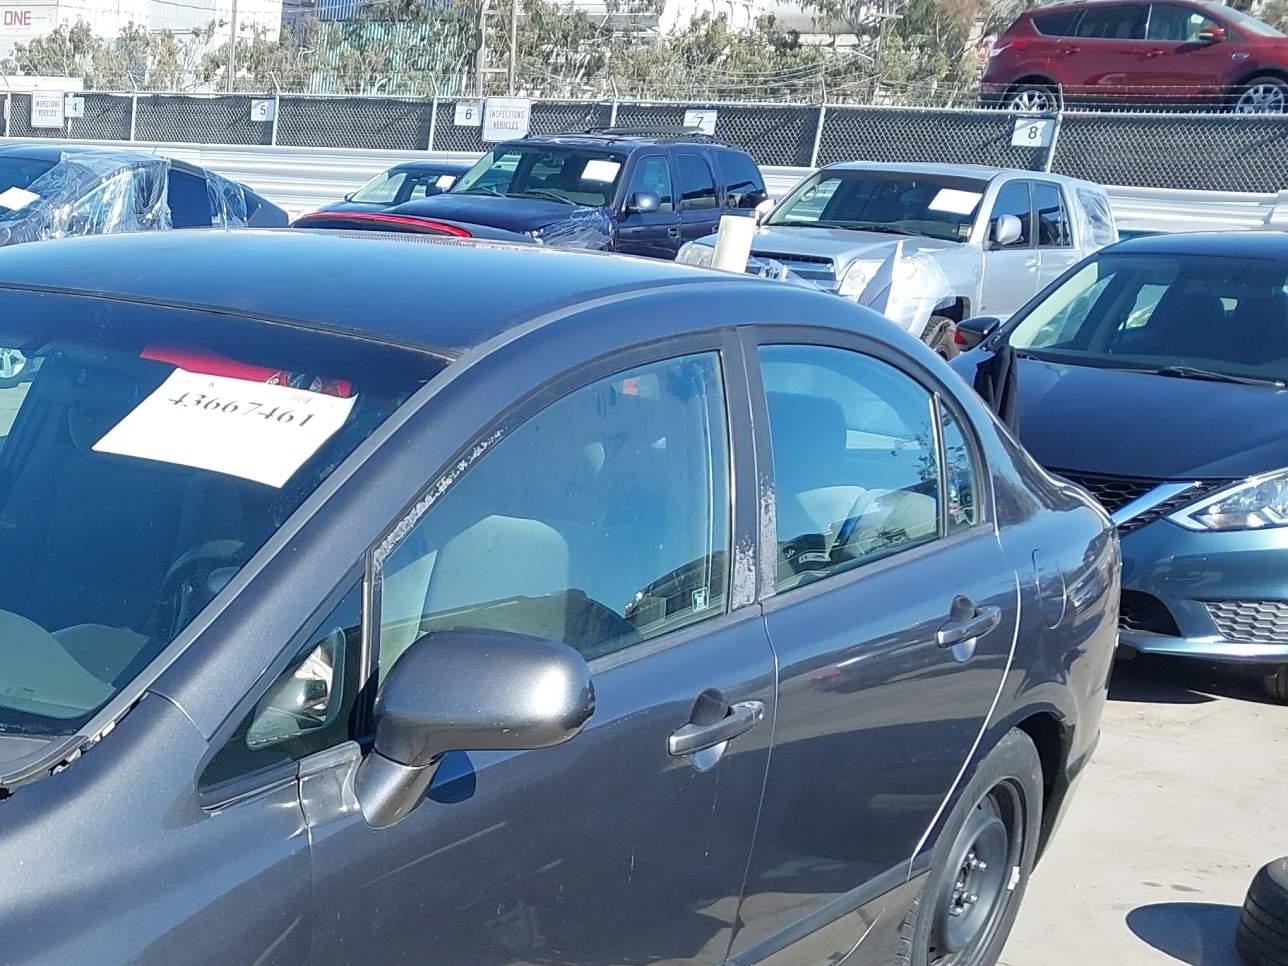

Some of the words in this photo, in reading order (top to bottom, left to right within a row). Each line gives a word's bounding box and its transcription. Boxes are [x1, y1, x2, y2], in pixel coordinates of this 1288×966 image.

[4, 10, 31, 26] ONE
[72, 102, 78, 113] 4
[259, 104, 266, 116] 5
[465, 108, 473, 120] 6
[489, 110, 525, 120] INSPECTIONS
[493, 120, 519, 130] VEHICLES
[696, 116, 704, 128] 7
[1028, 125, 1039, 140] 8
[168, 391, 315, 428] 43667461
